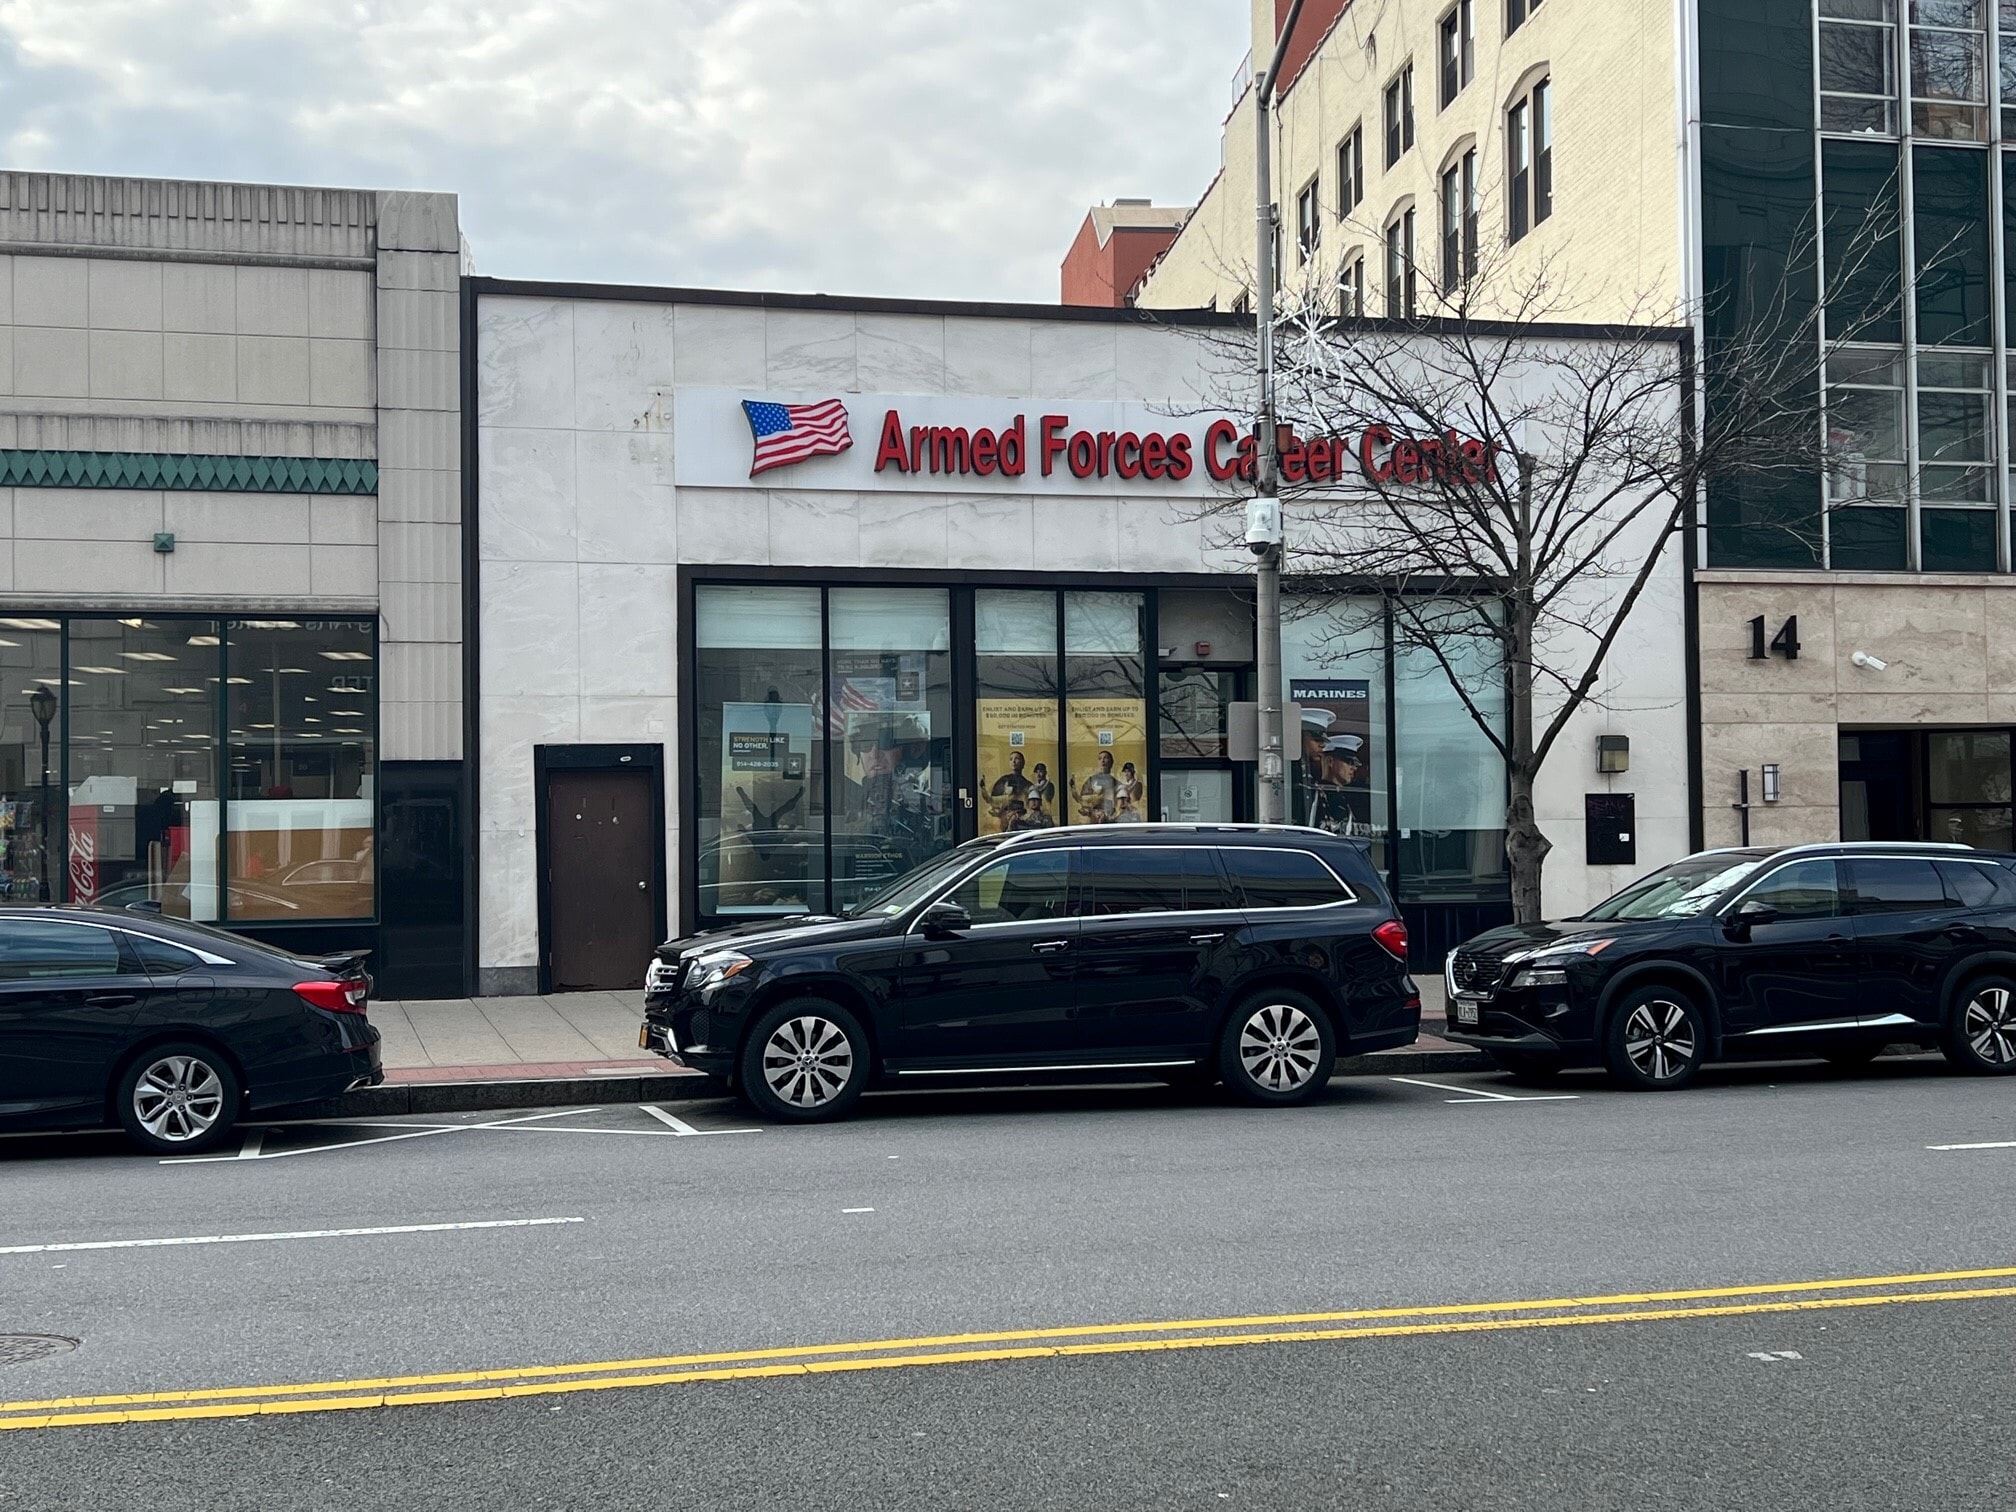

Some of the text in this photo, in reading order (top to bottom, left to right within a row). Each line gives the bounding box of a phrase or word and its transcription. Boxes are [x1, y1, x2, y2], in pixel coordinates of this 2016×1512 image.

[874, 410, 1025, 476] Armed
[1040, 415, 1193, 480] Forces
[1204, 419, 1349, 482] Caeer
[1746, 614, 1801, 660] 14
[1293, 690, 1367, 699] MARINES
[769, 736, 785, 744] LIKE
